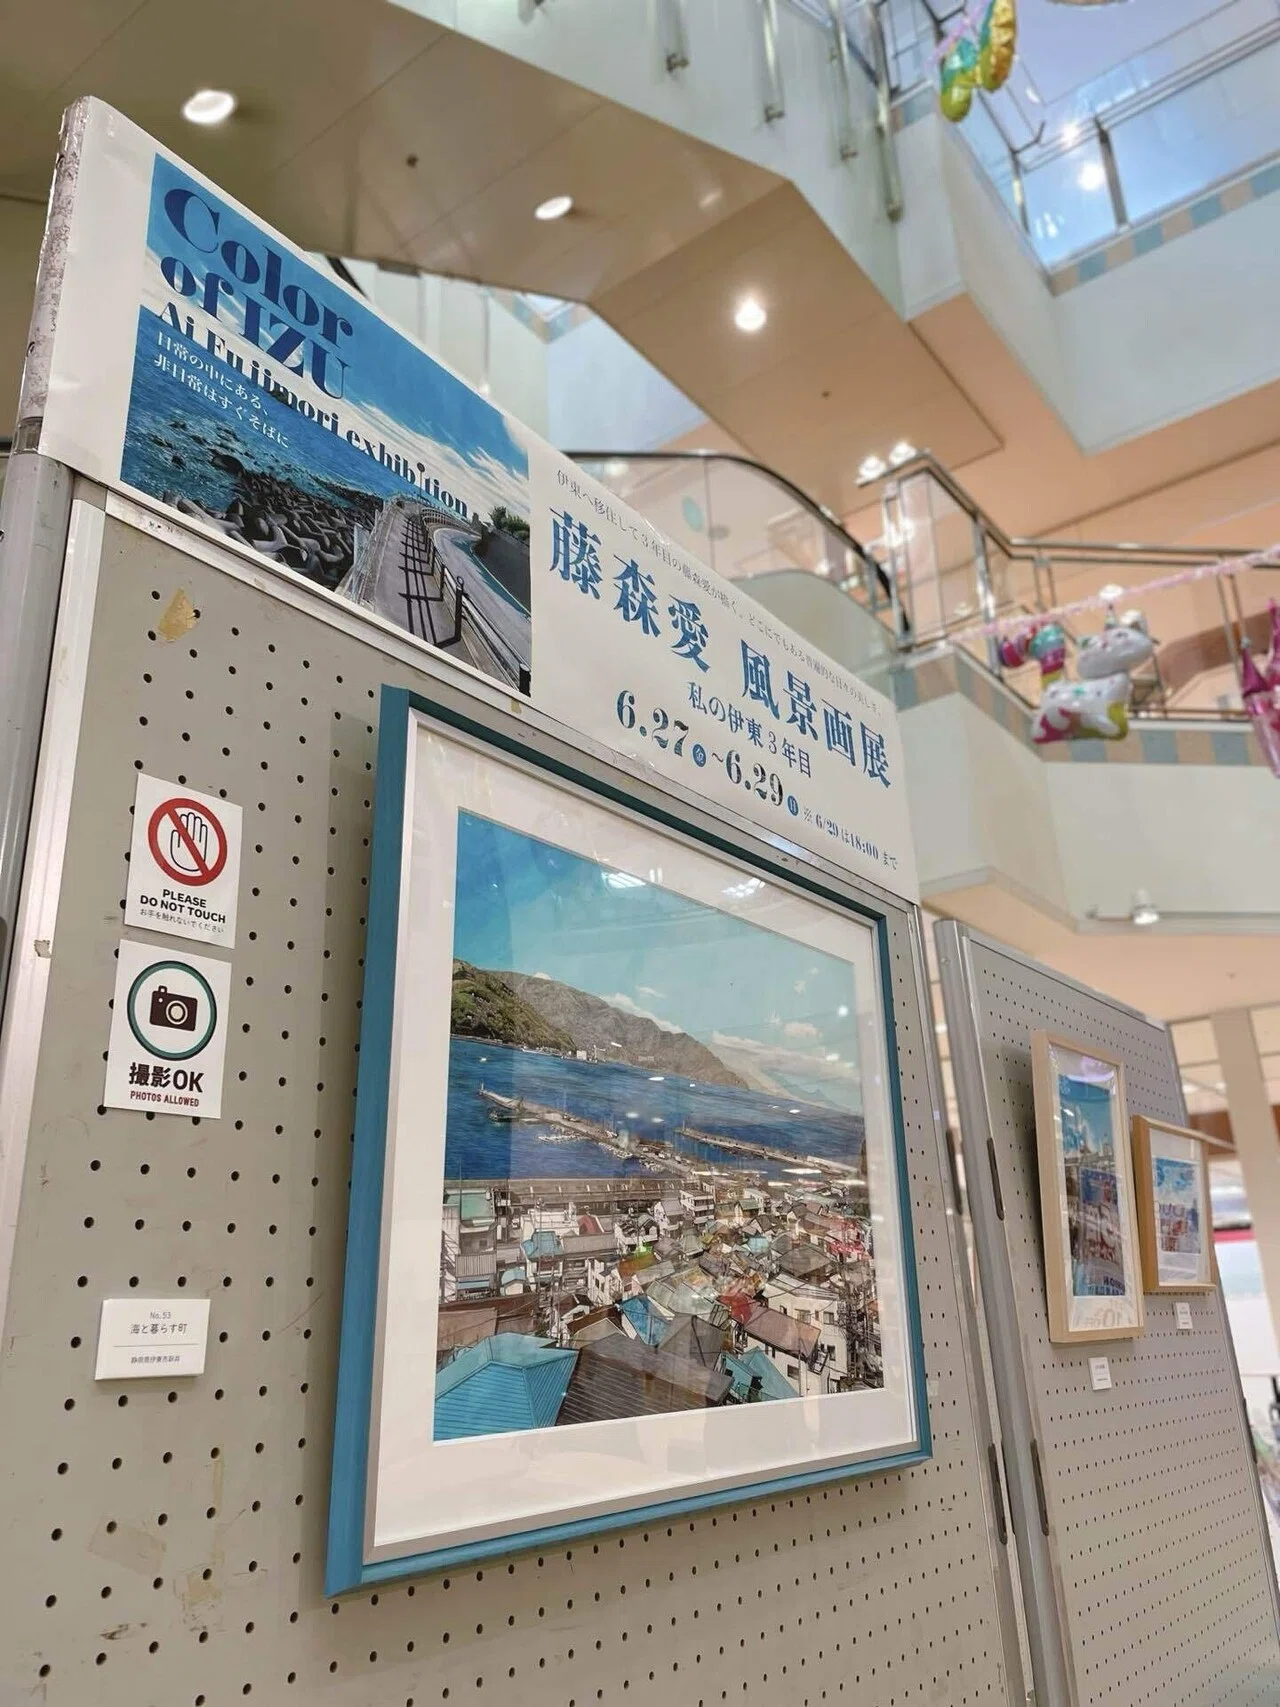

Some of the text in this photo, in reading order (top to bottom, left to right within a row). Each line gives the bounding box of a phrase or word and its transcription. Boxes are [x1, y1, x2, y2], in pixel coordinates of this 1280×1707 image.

[164, 188, 353, 349] Color
[160, 256, 348, 399] of IZU
[154, 353, 289, 449] 非日常はすぐそばに
[158, 330, 268, 416] 日常の中にある、
[158, 302, 468, 518] Ai Fujimori exhibition
[549, 507, 892, 789] 藤森愛 風景画展
[686, 681, 812, 779] 私の伊東3年目
[140, 894, 226, 924] DO NOT TOUCH
[140, 908, 225, 934] お手を触れないでください
[162, 888, 207, 909] PLEASE
[128, 1061, 205, 1094] 撮影OK
[130, 1090, 200, 1108] PHOTOS ALLOWED
[130, 1323, 188, 1335] 海と暮らす町
